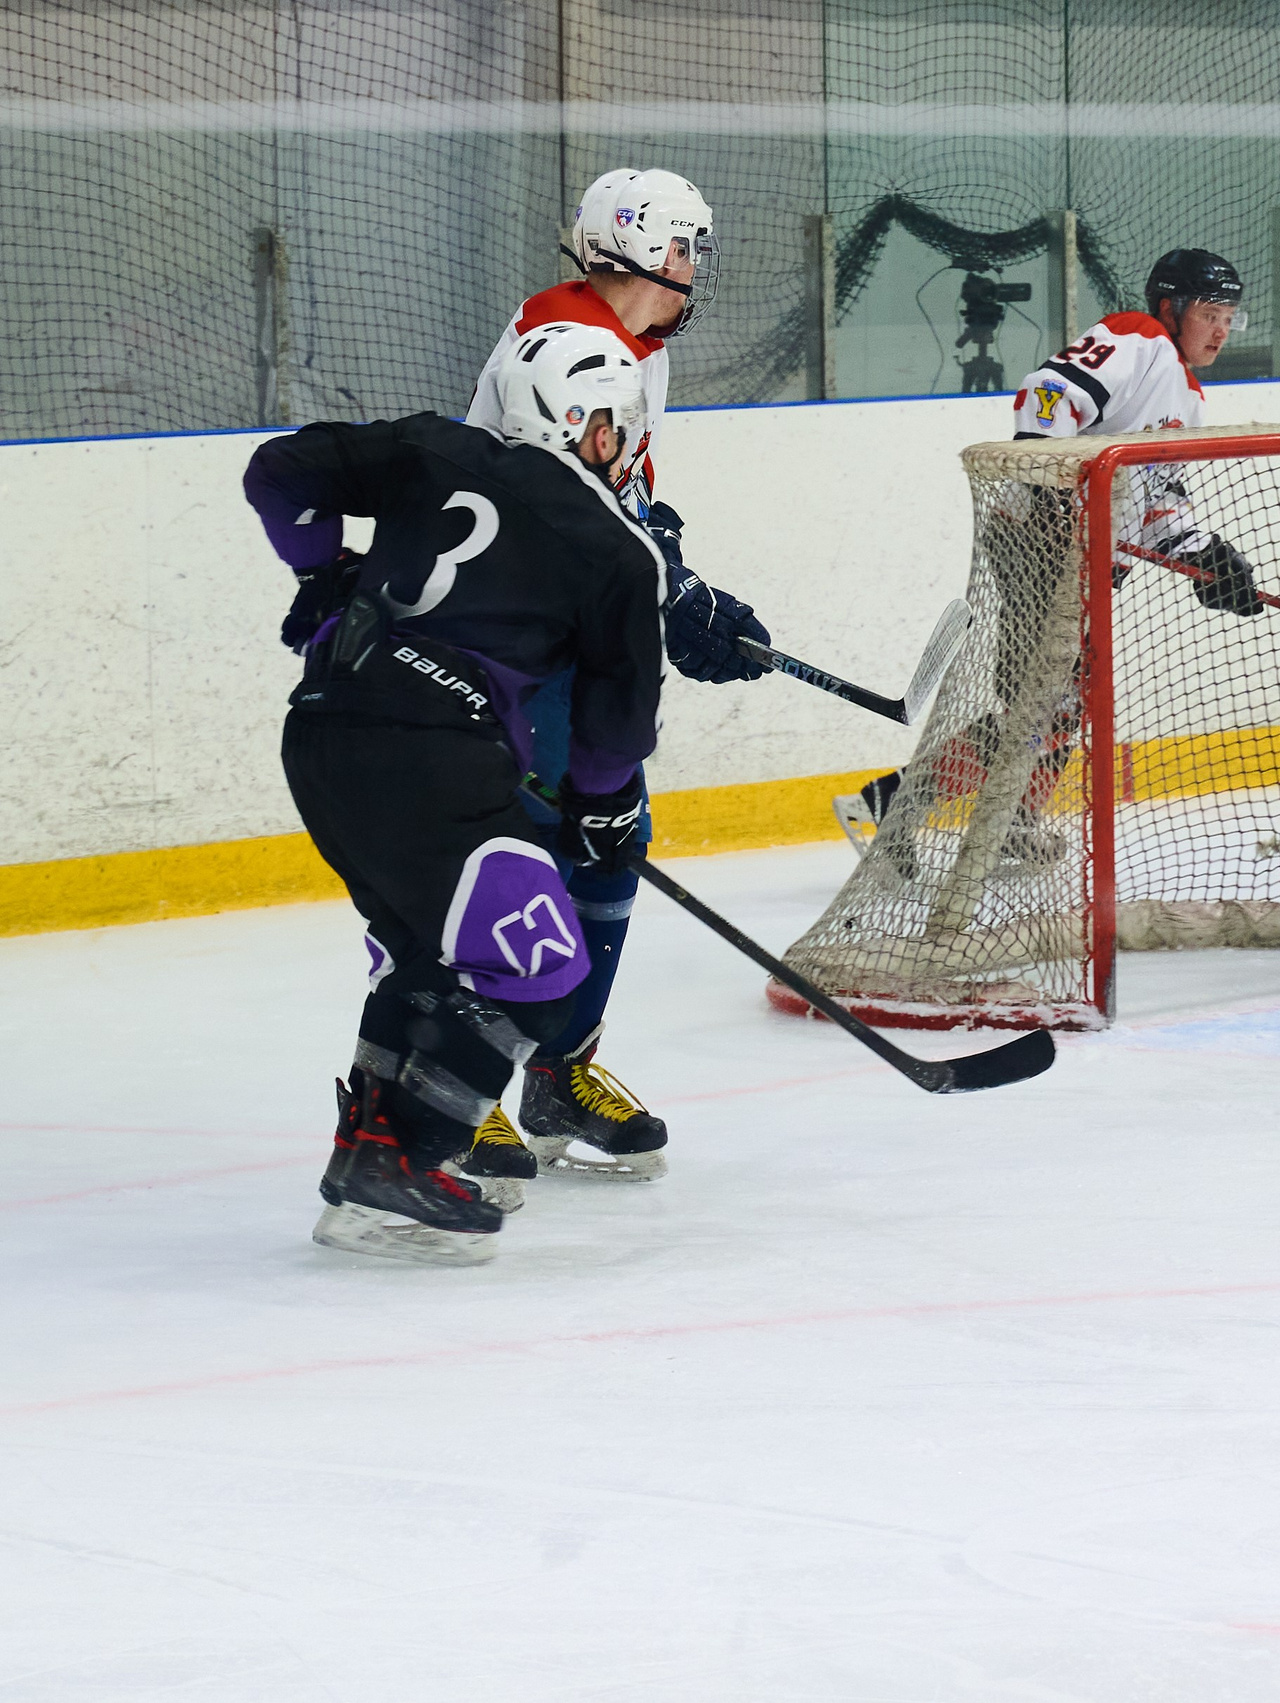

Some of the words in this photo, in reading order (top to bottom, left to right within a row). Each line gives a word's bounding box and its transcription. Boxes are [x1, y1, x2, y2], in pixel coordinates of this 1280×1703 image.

[670, 219, 695, 228] CCM
[1055, 335, 1117, 370] 29
[378, 490, 500, 621] 3
[770, 653, 841, 696] SOYUZ
